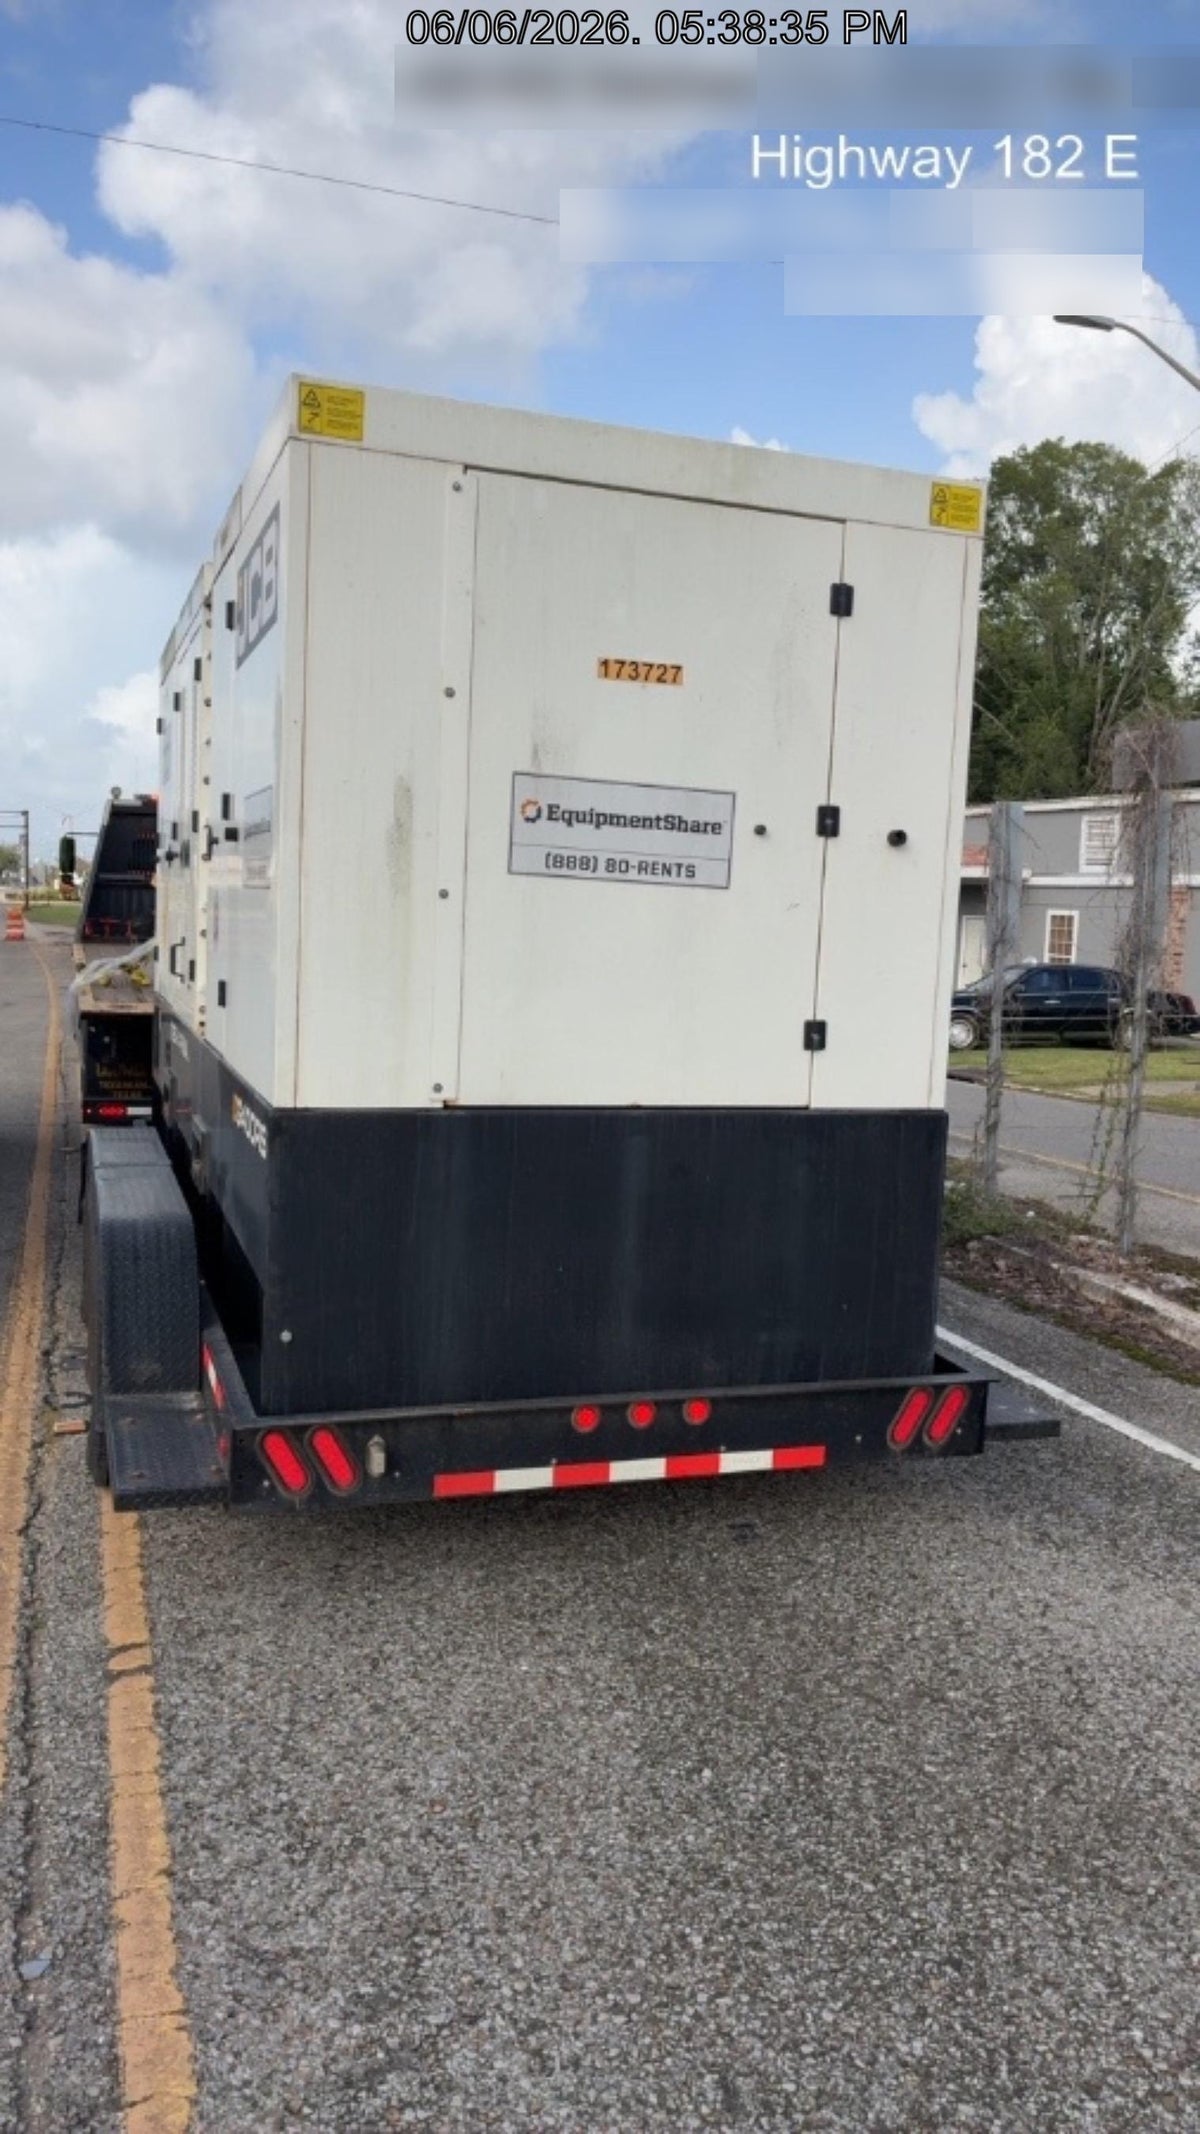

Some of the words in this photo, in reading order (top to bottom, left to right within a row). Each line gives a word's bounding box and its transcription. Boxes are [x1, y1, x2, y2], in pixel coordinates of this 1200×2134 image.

[600, 659, 683, 684] 173727
[547, 803, 723, 836] EquipmentShare
[545, 852, 598, 873] (888)
[604, 857, 696, 879] 80-RENTS
